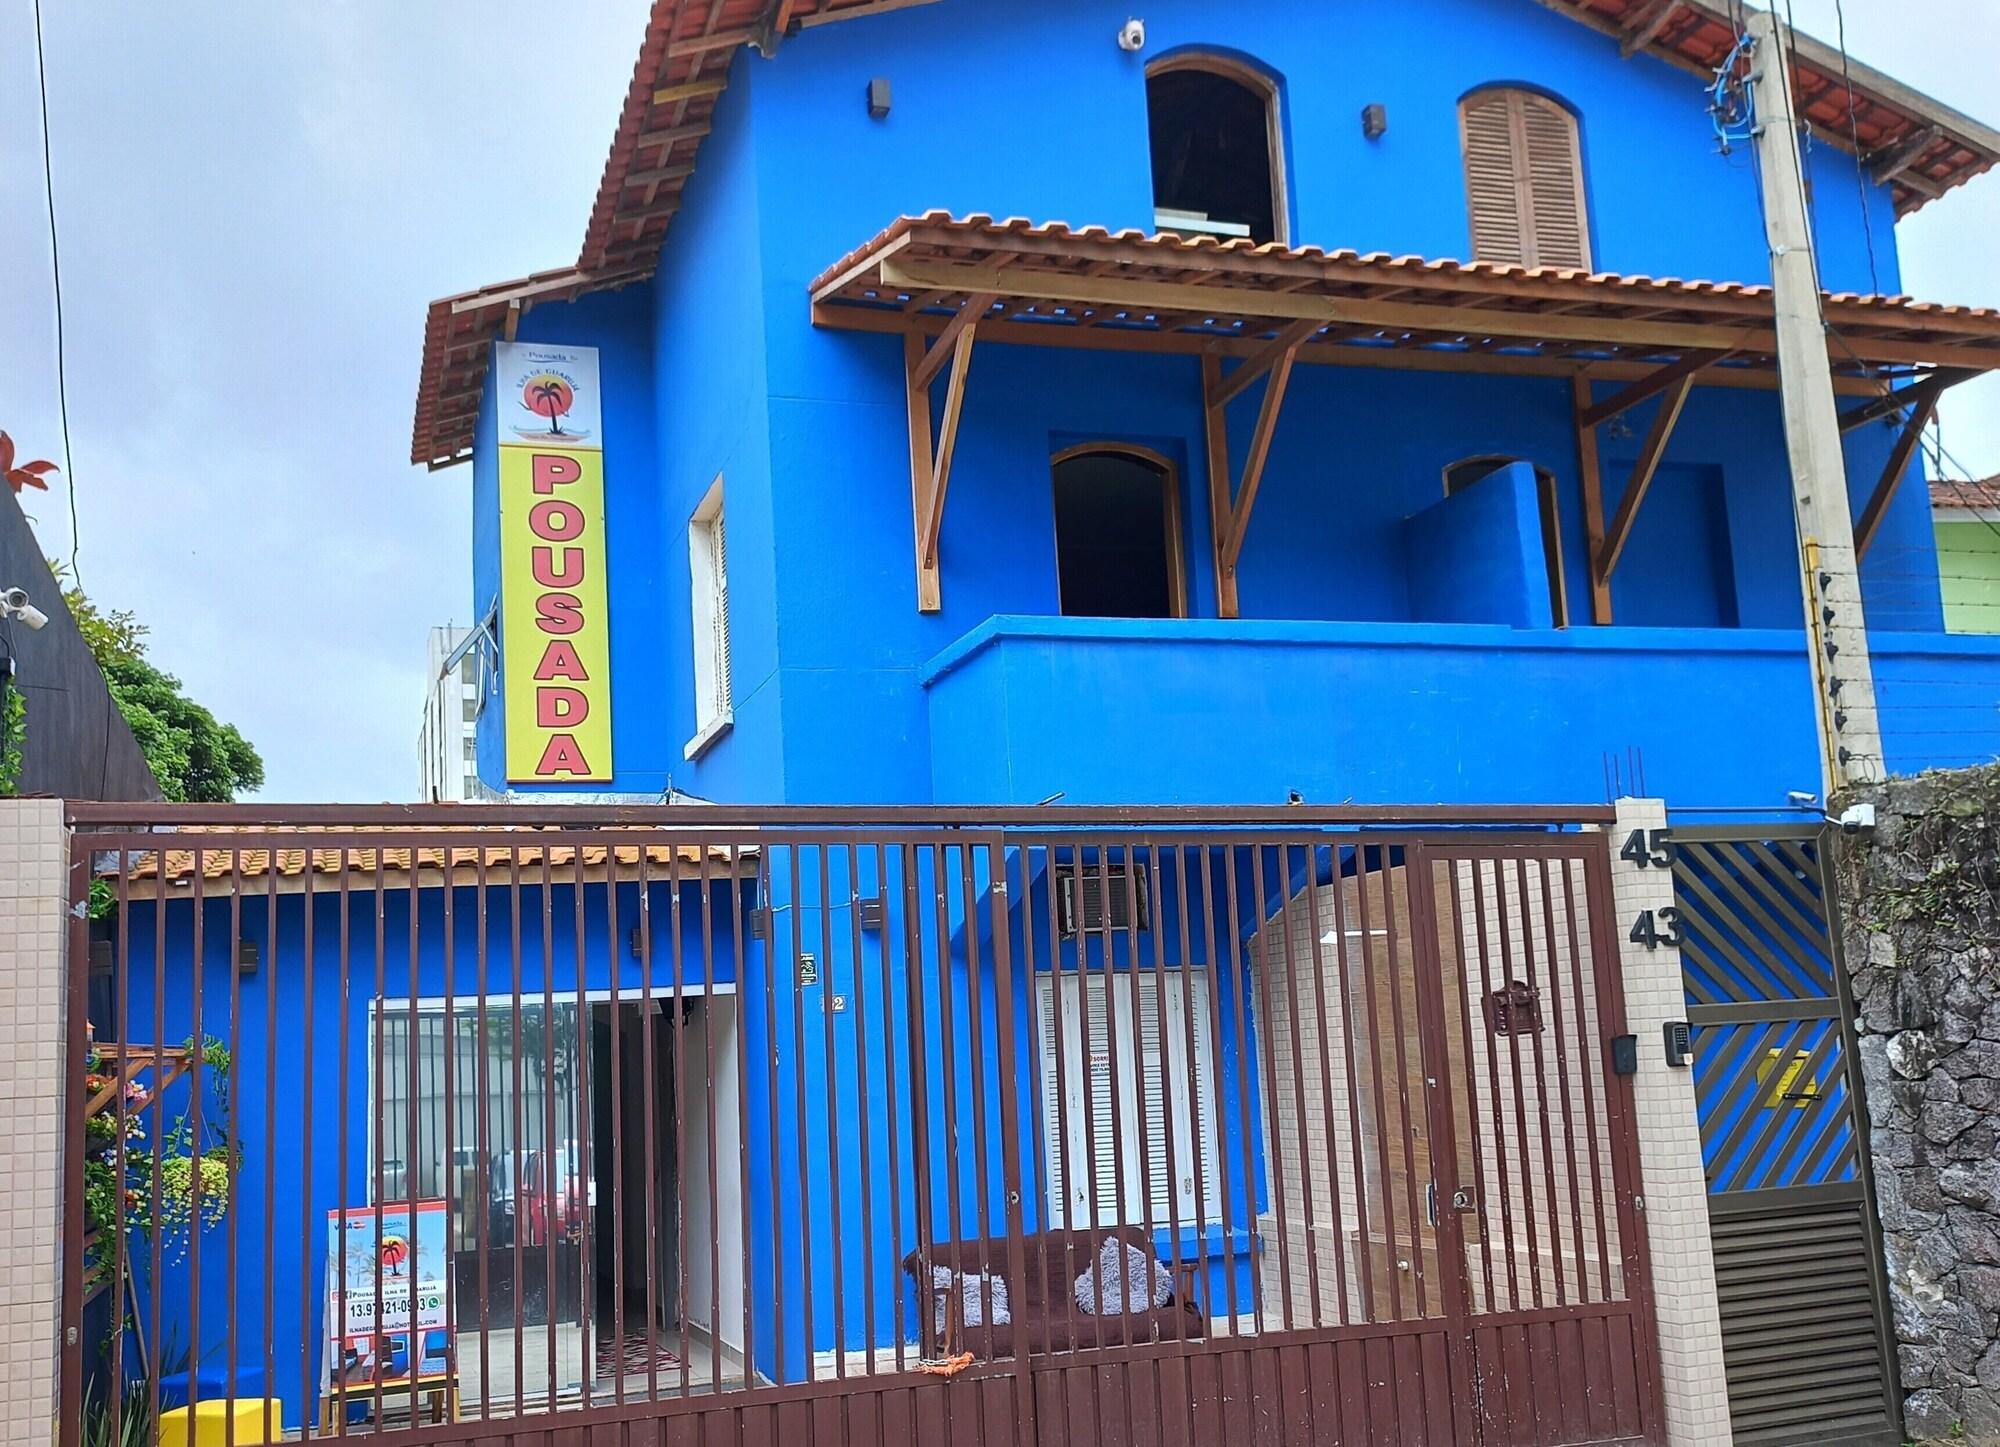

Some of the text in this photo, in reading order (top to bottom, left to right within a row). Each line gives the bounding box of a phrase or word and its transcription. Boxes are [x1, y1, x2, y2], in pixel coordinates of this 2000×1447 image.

[528, 454, 592, 775] POUSADA
[1620, 829, 1677, 869] 45
[1629, 907, 1686, 951] 43
[350, 1297, 426, 1318] 13.9721-093
